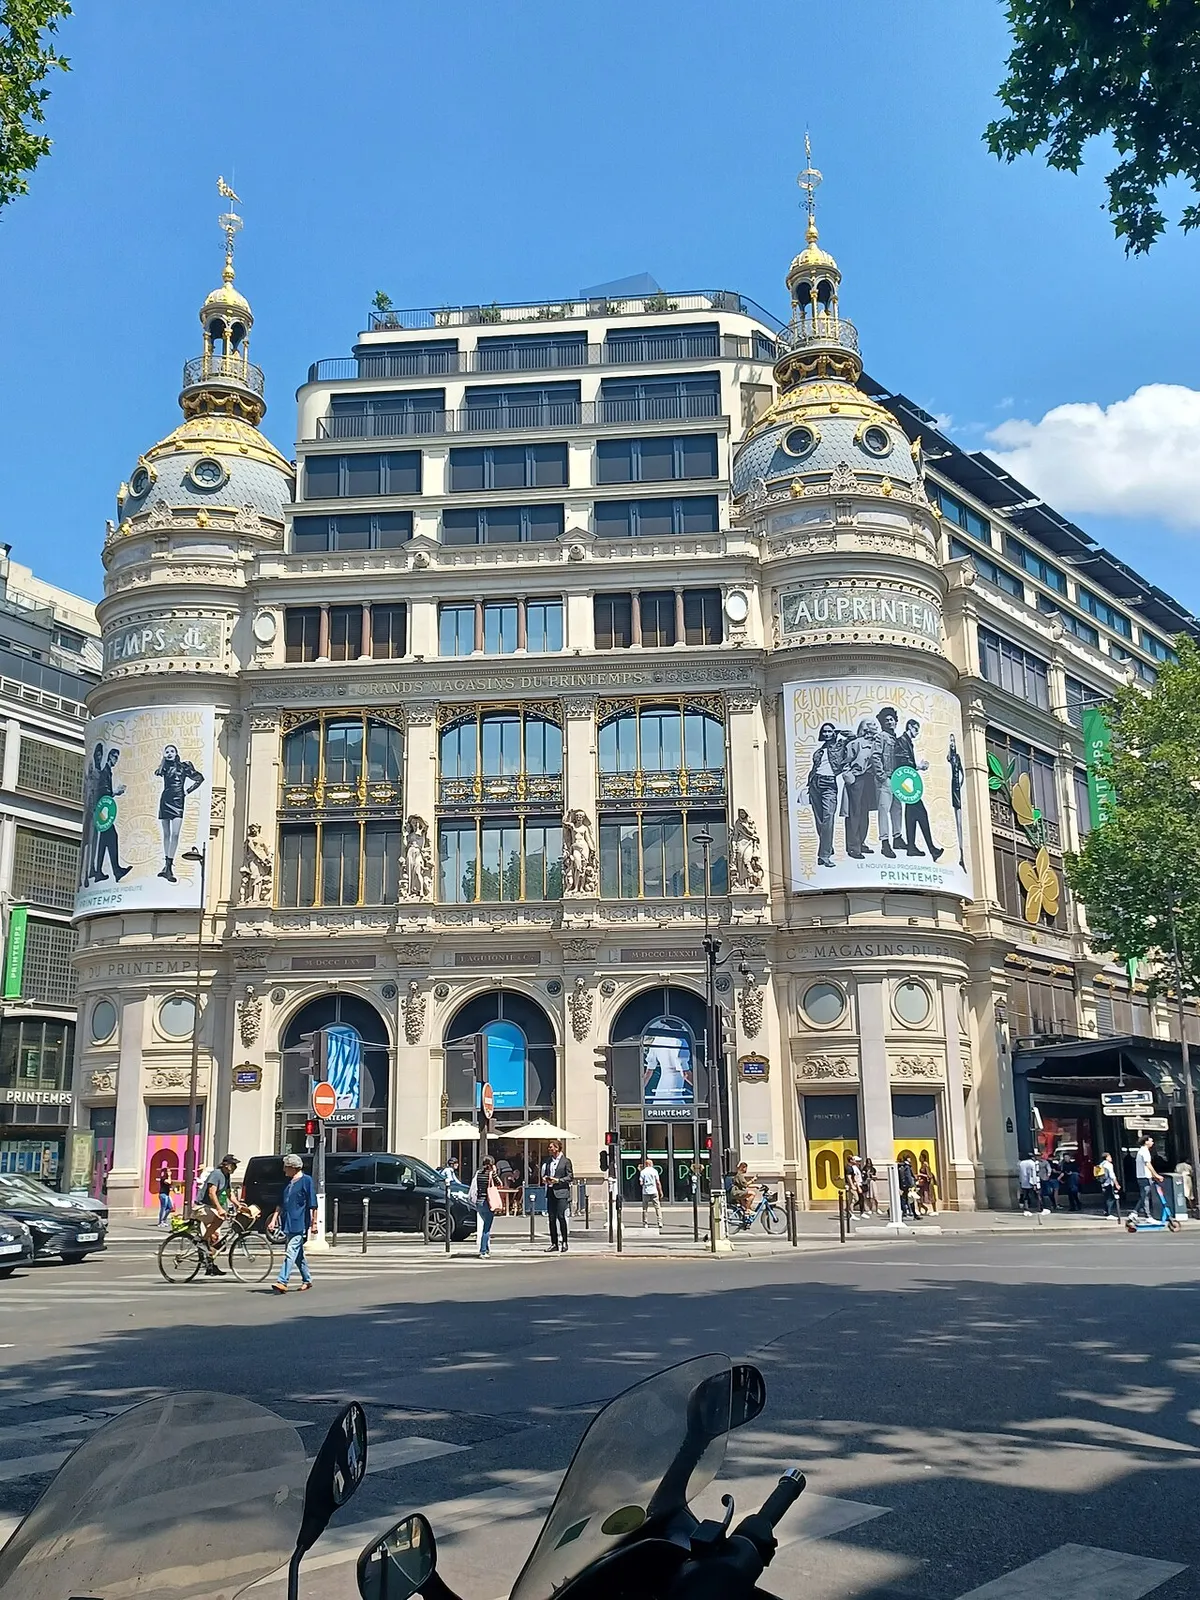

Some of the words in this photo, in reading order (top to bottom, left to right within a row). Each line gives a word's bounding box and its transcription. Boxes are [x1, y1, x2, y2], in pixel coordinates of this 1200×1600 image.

[794, 599, 829, 625] AU
[107, 628, 166, 661] TEMPS
[356, 680, 423, 696] GRANDS
[430, 677, 515, 692] MAGASINS
[520, 676, 543, 688] DU
[549, 671, 644, 687] PRINTEMPS
[793, 685, 863, 712] REJOIGNEZ
[876, 685, 909, 709] CLUB
[880, 871, 943, 885] PRINTEMPS
[10, 926, 21, 979] PRINTEMPS
[814, 944, 904, 958] MAGASINS
[6, 1090, 72, 1104] PRINTEMPS
